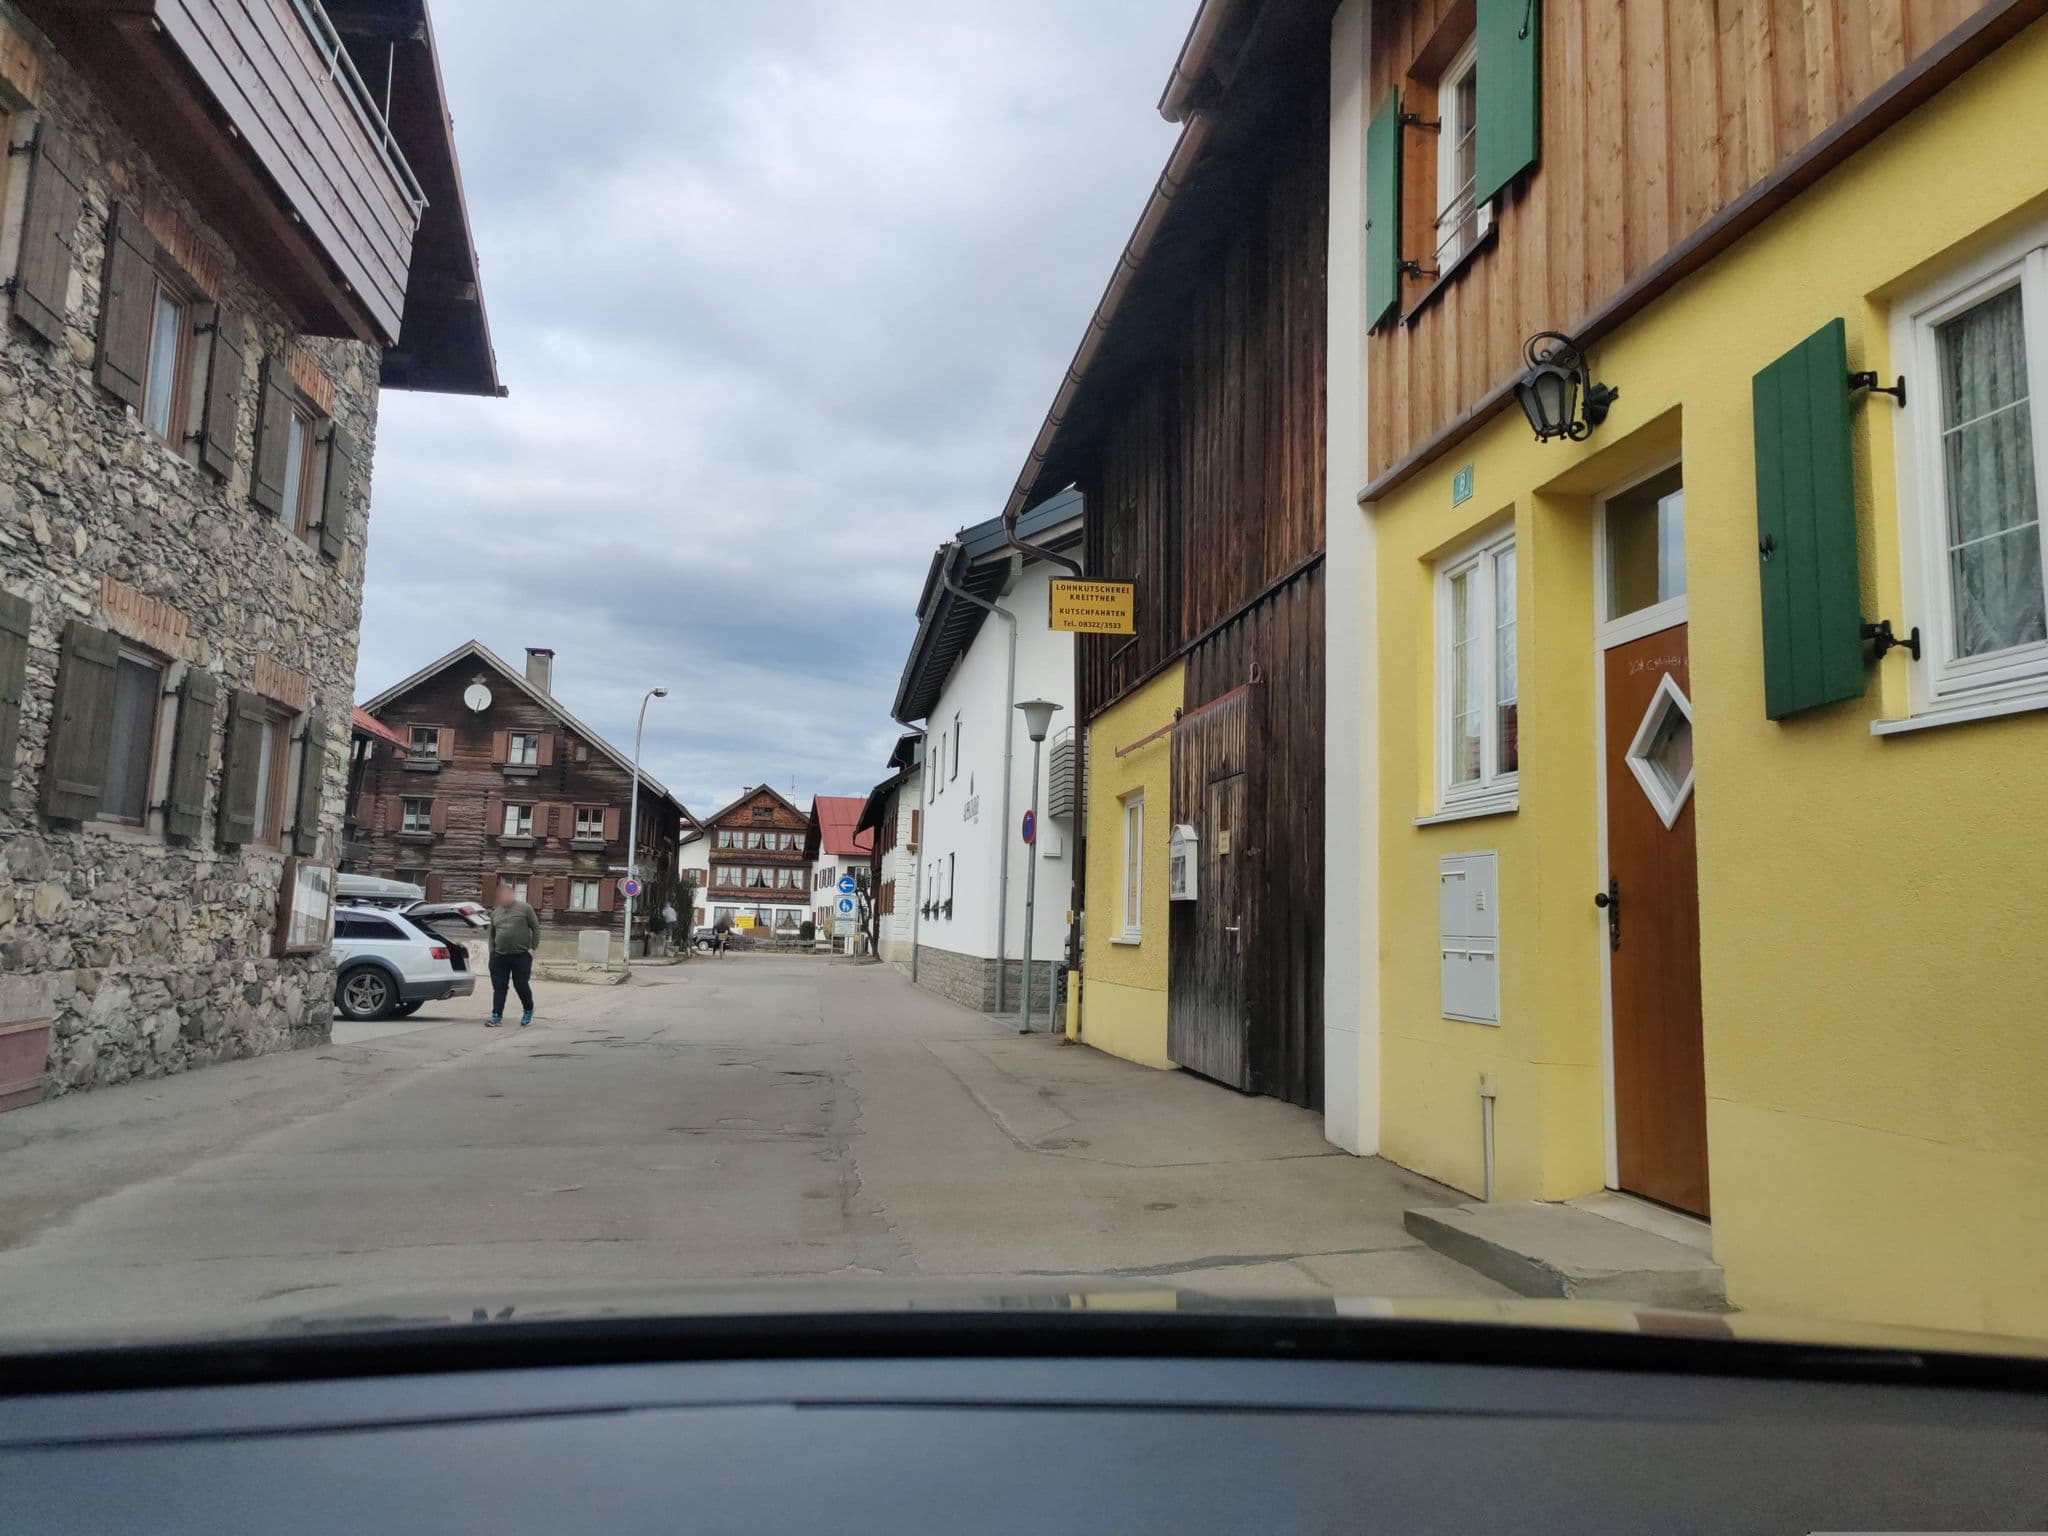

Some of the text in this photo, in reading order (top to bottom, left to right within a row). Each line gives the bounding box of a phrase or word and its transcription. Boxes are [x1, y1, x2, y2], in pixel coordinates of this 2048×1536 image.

[1056, 584, 1130, 594] LOHNKUTSCHEREI
[1069, 594, 1116, 602] KREITTNER
[1059, 607, 1126, 617] KUTSCHFAHRTEN
